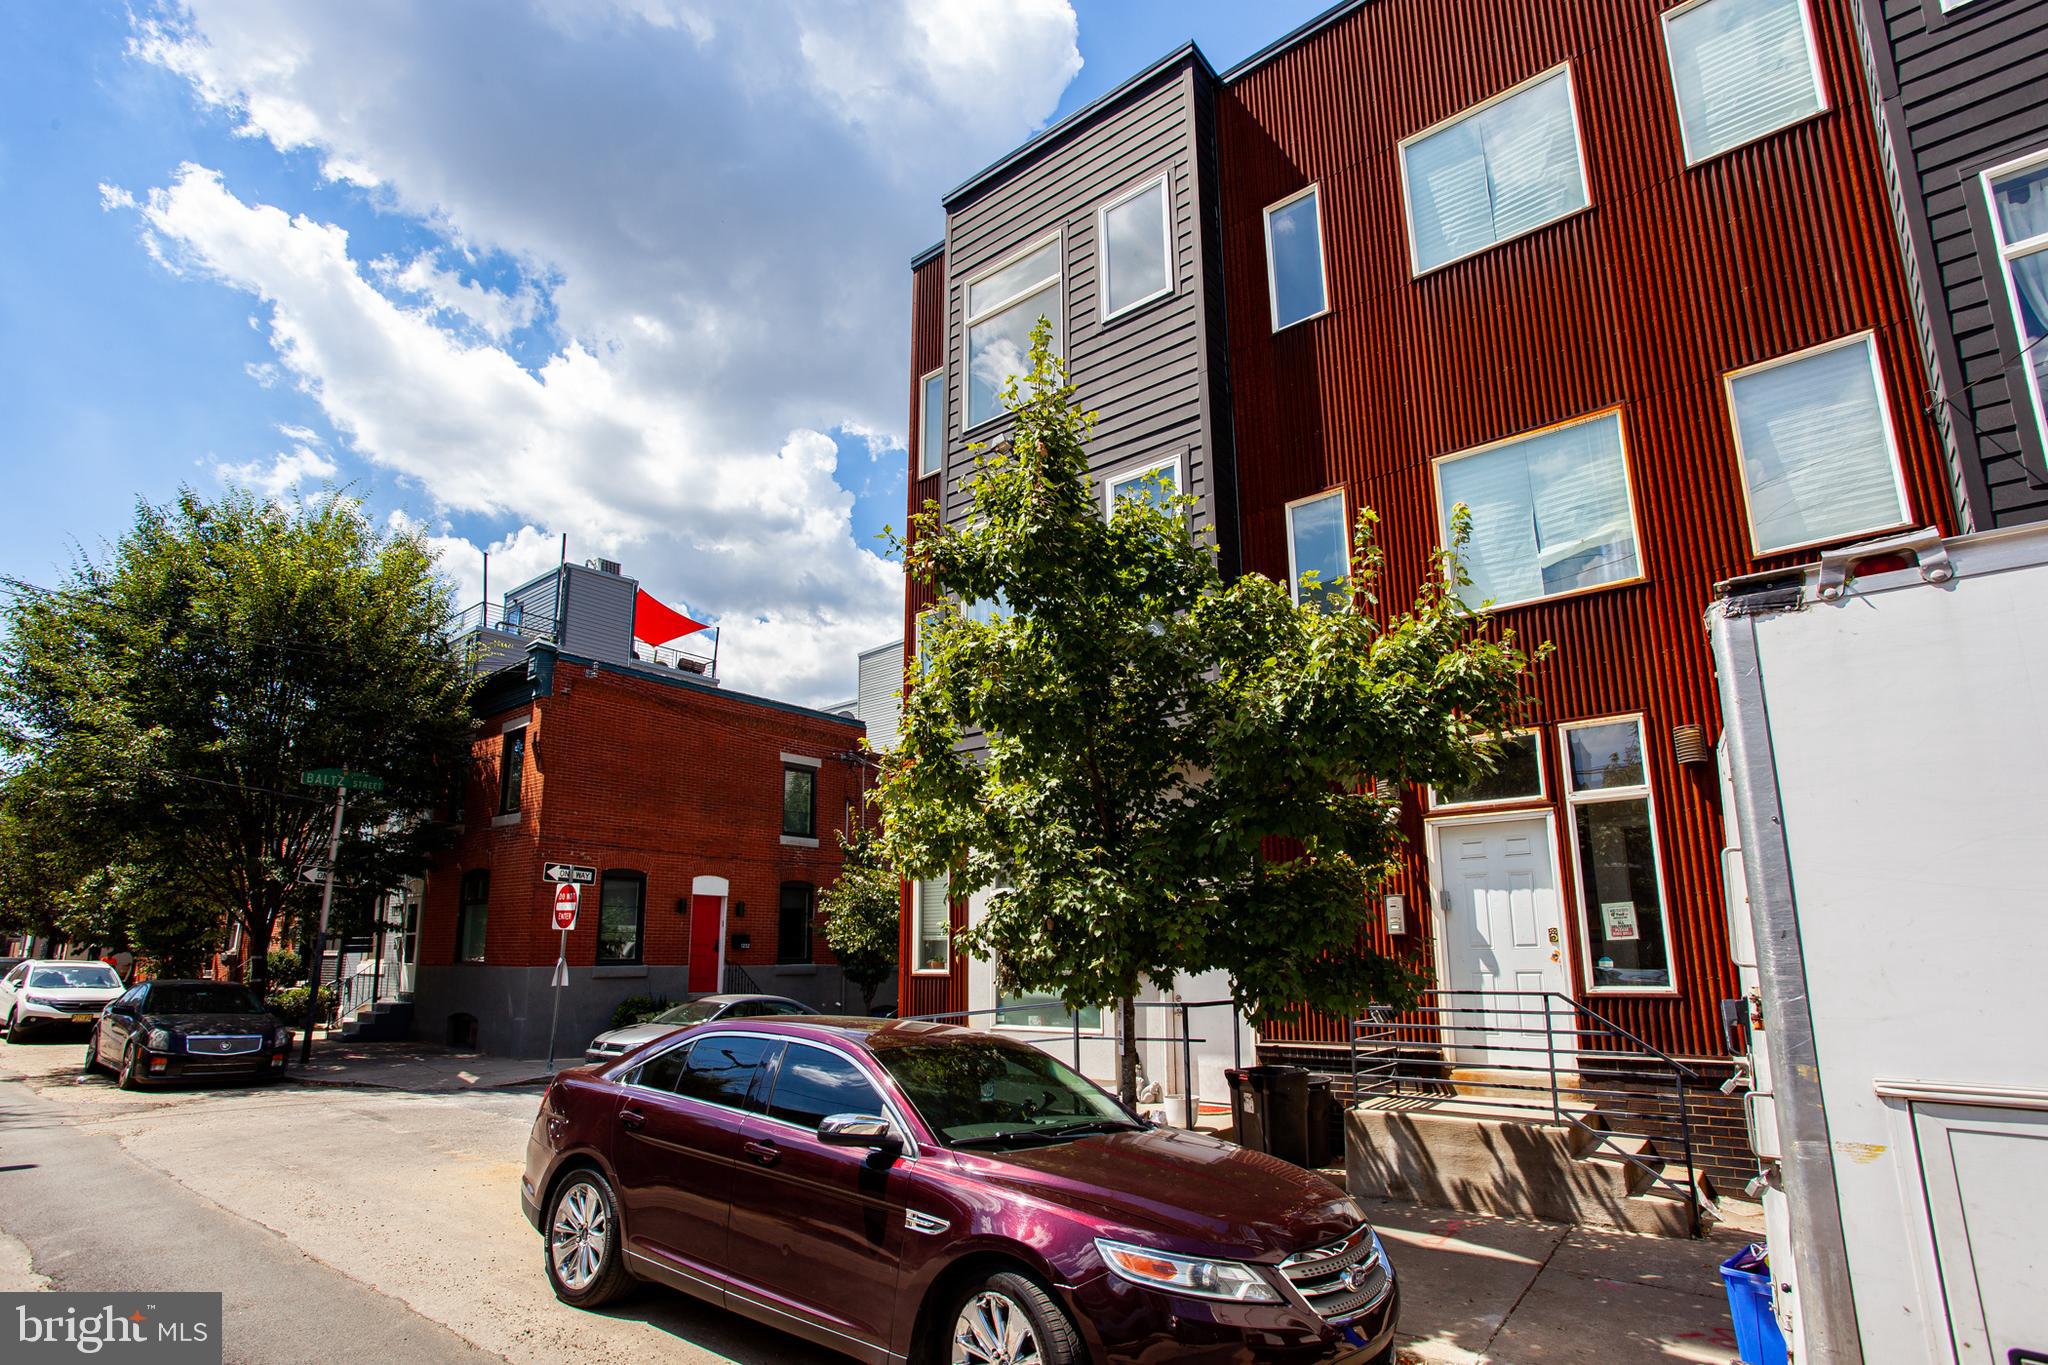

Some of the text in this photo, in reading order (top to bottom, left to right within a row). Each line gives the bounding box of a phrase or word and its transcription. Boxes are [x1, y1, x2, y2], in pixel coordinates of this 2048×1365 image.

[306, 773, 344, 786] BALTZ
[352, 780, 382, 790] STREET
[575, 872, 590, 880] WAY
